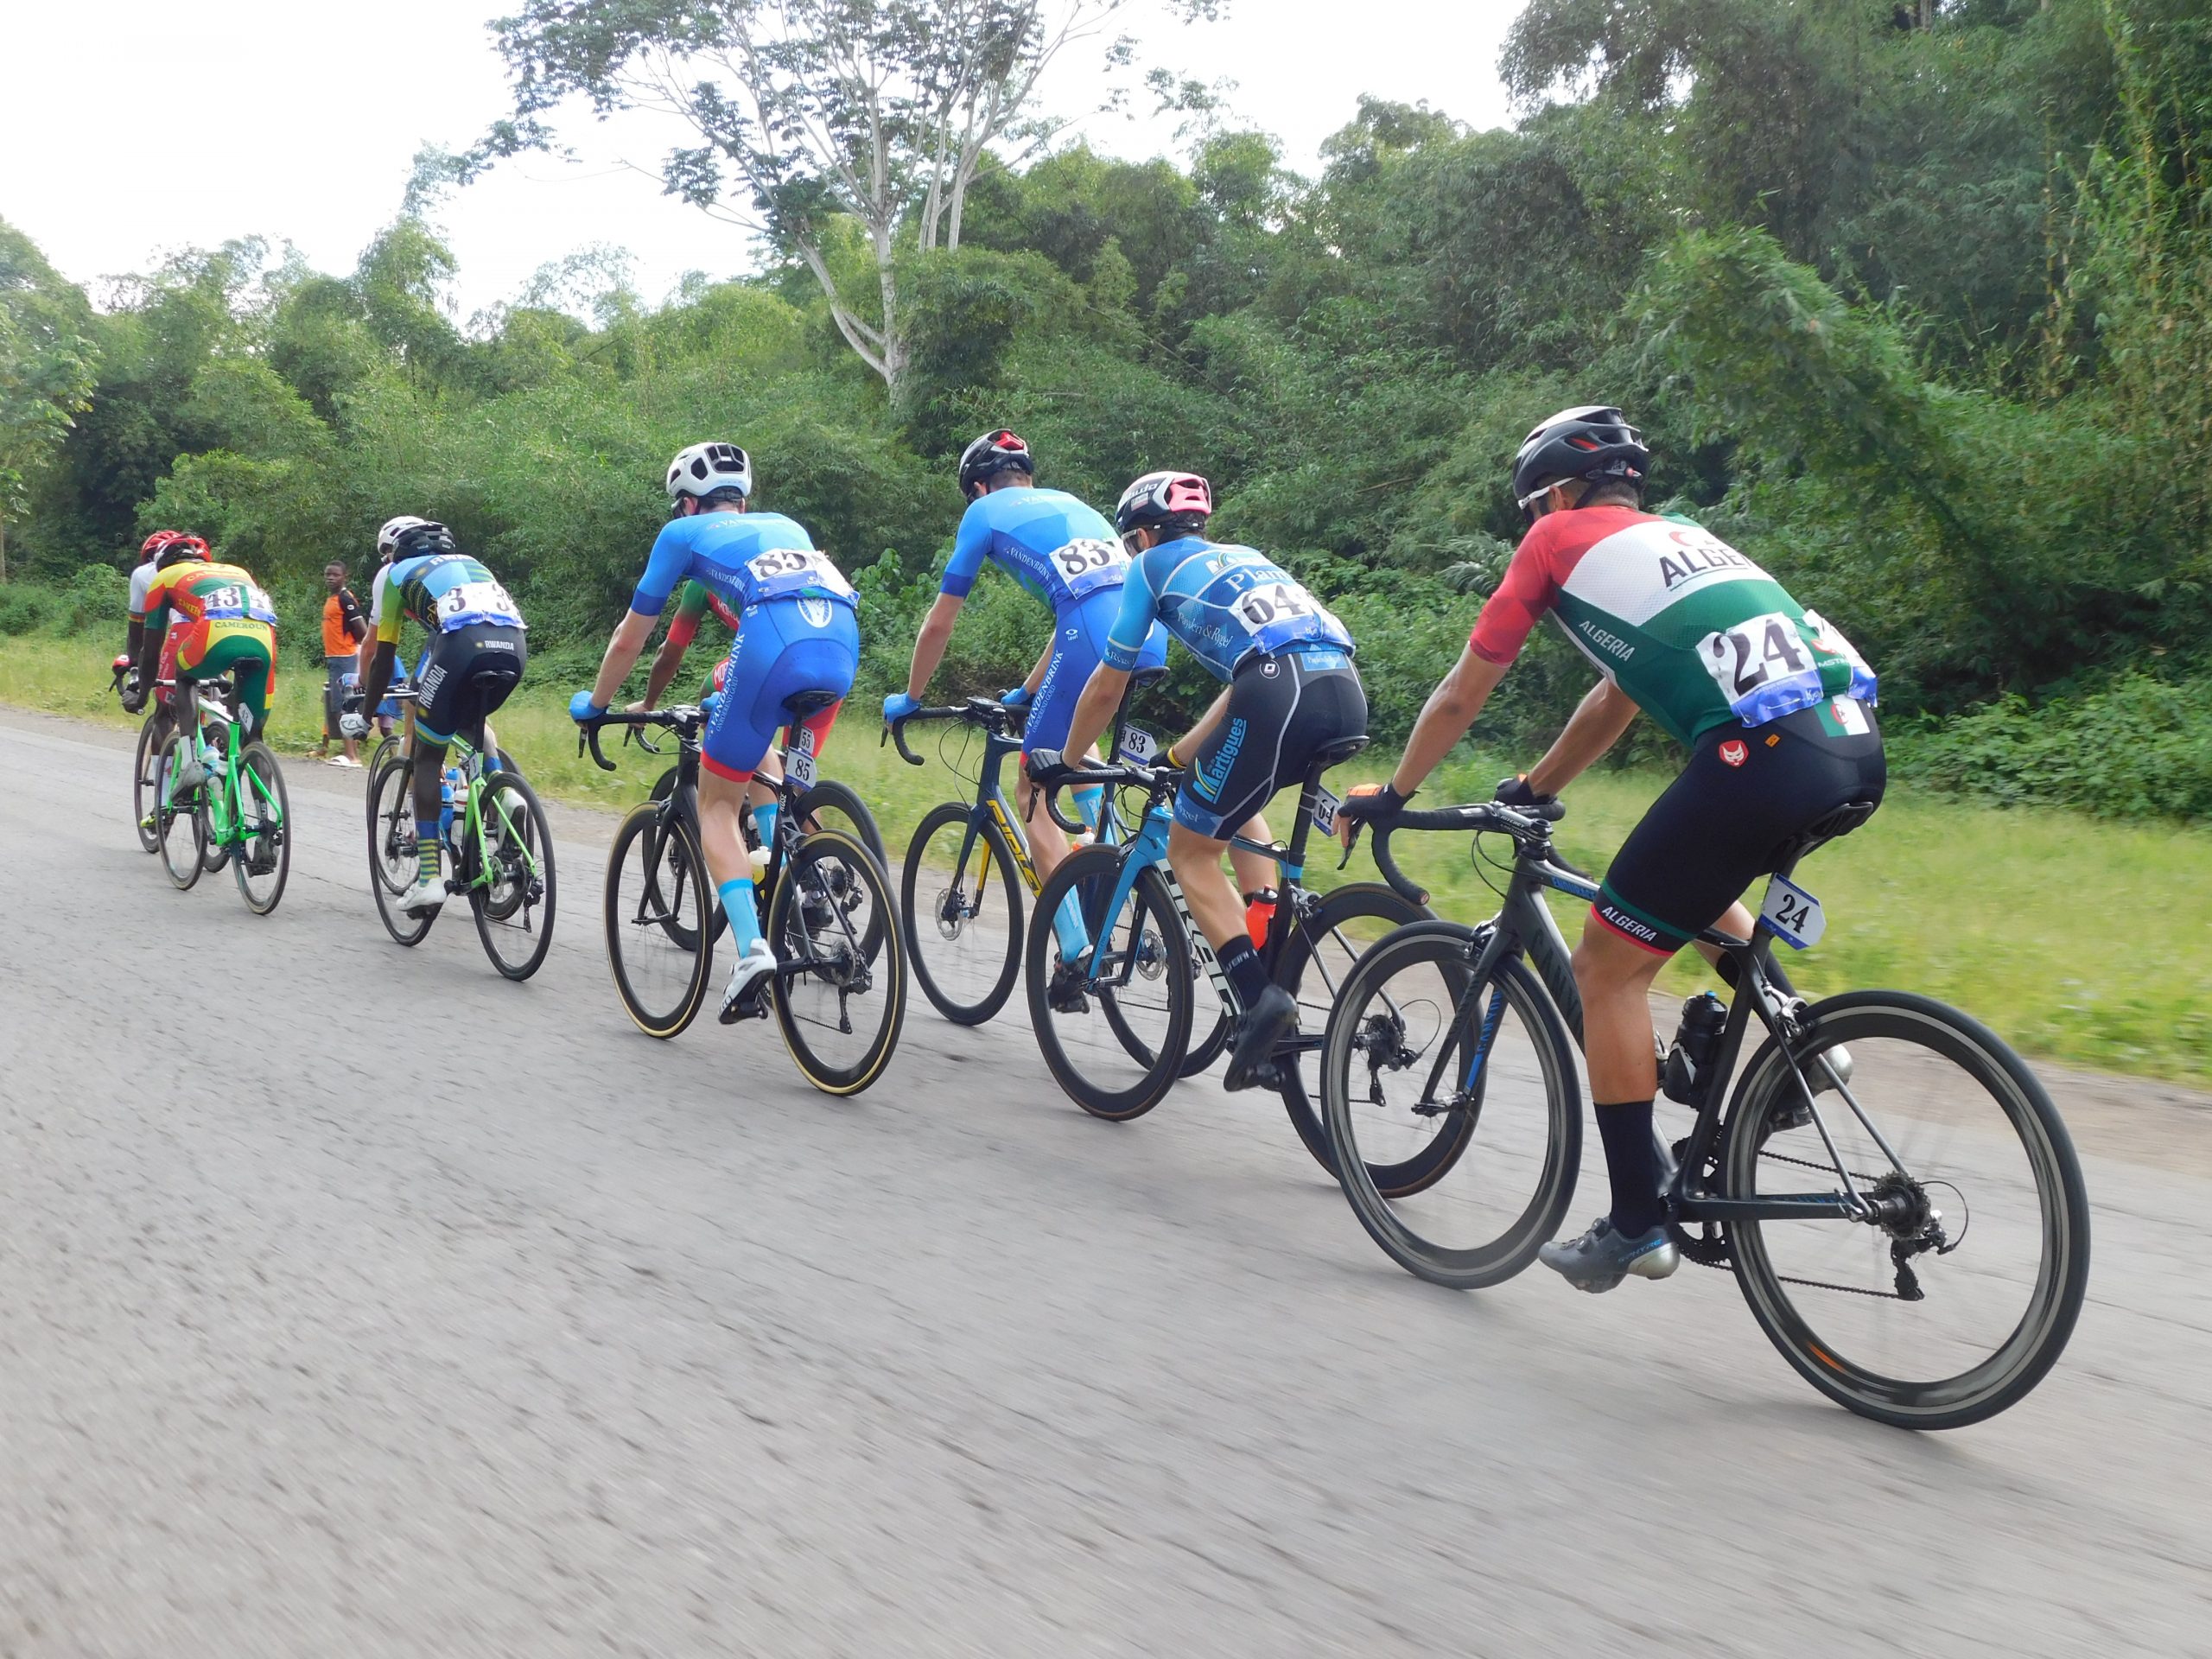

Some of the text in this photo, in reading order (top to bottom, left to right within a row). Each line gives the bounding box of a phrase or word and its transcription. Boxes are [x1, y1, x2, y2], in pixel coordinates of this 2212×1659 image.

[1058, 539, 1110, 575] 83
[1659, 549, 1752, 588] ALGE
[208, 587, 239, 607] 43
[214, 621, 268, 631] CAMEROUN
[1211, 626, 1234, 649] Rygel
[1579, 620, 1635, 661] ALGERIA
[485, 640, 515, 651] RWANDA
[1713, 619, 1805, 696] 24
[418, 664, 448, 709] RWANDA
[710, 632, 745, 727] VANDENBRINK
[1027, 651, 1064, 728] VANDENBRINK
[801, 731, 811, 748] 55
[1128, 732, 1146, 753] 83
[795, 759, 810, 781] 85
[1192, 718, 1243, 804] Martigues
[1601, 906, 1657, 943] ALGERIA
[1776, 893, 1810, 934] 24
